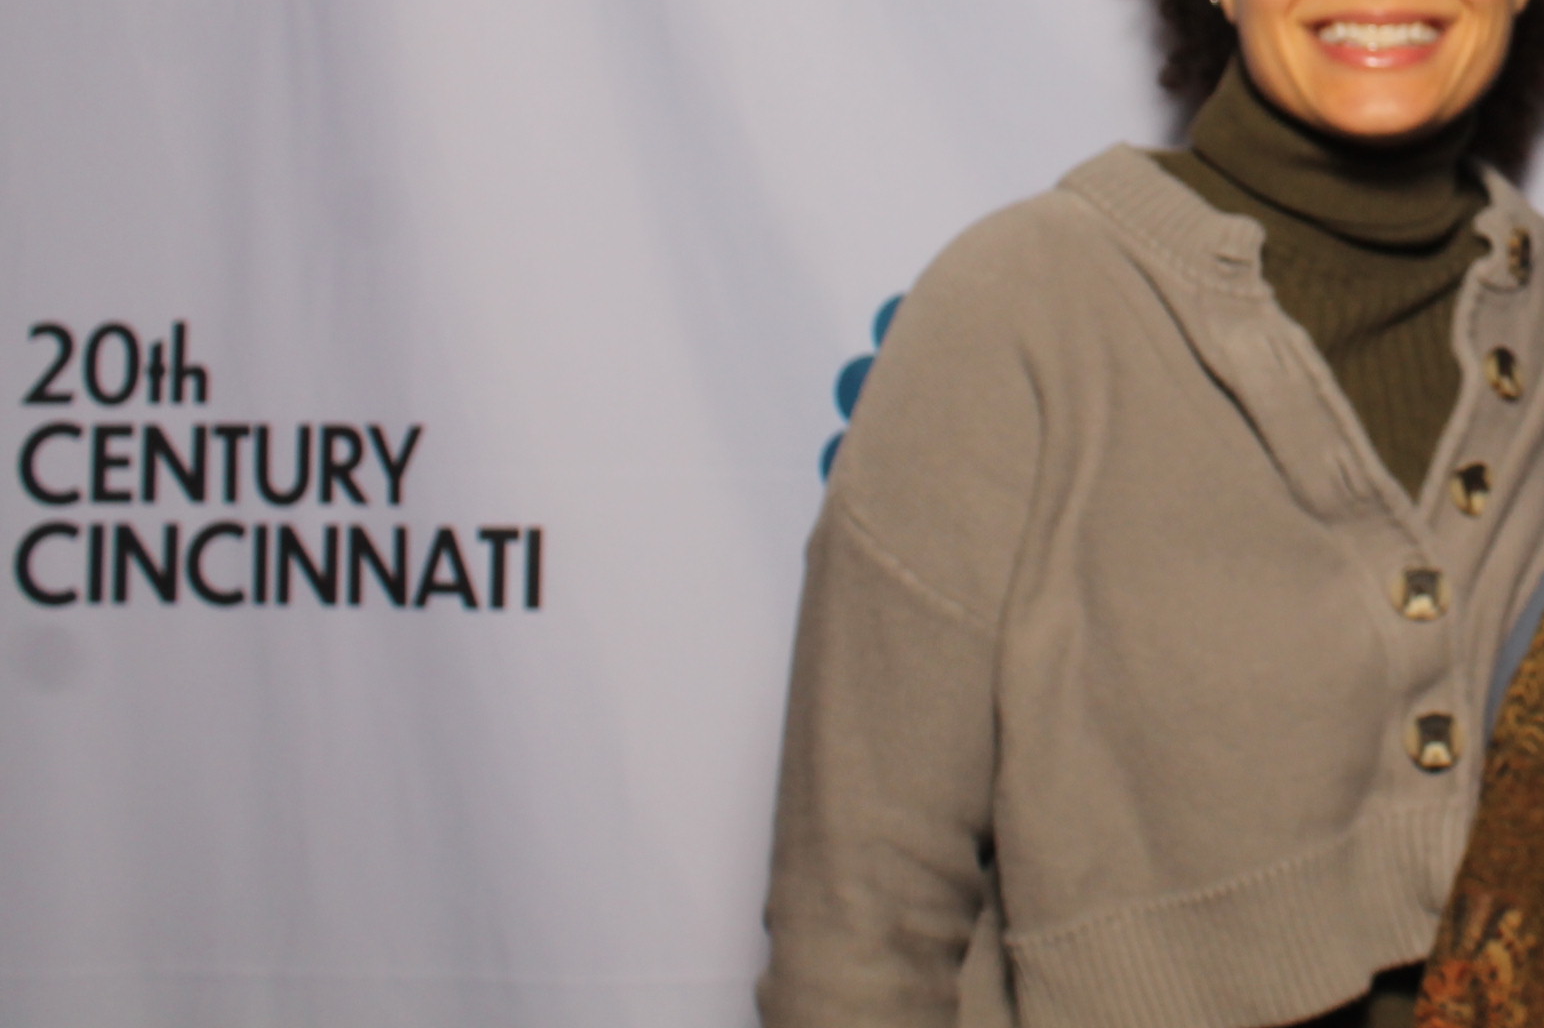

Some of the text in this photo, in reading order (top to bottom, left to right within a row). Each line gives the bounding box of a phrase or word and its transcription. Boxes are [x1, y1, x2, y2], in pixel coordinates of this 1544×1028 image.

[20, 320, 210, 409] 20th
[17, 420, 423, 508] CENTURY
[12, 520, 542, 611] CINCINNATI
